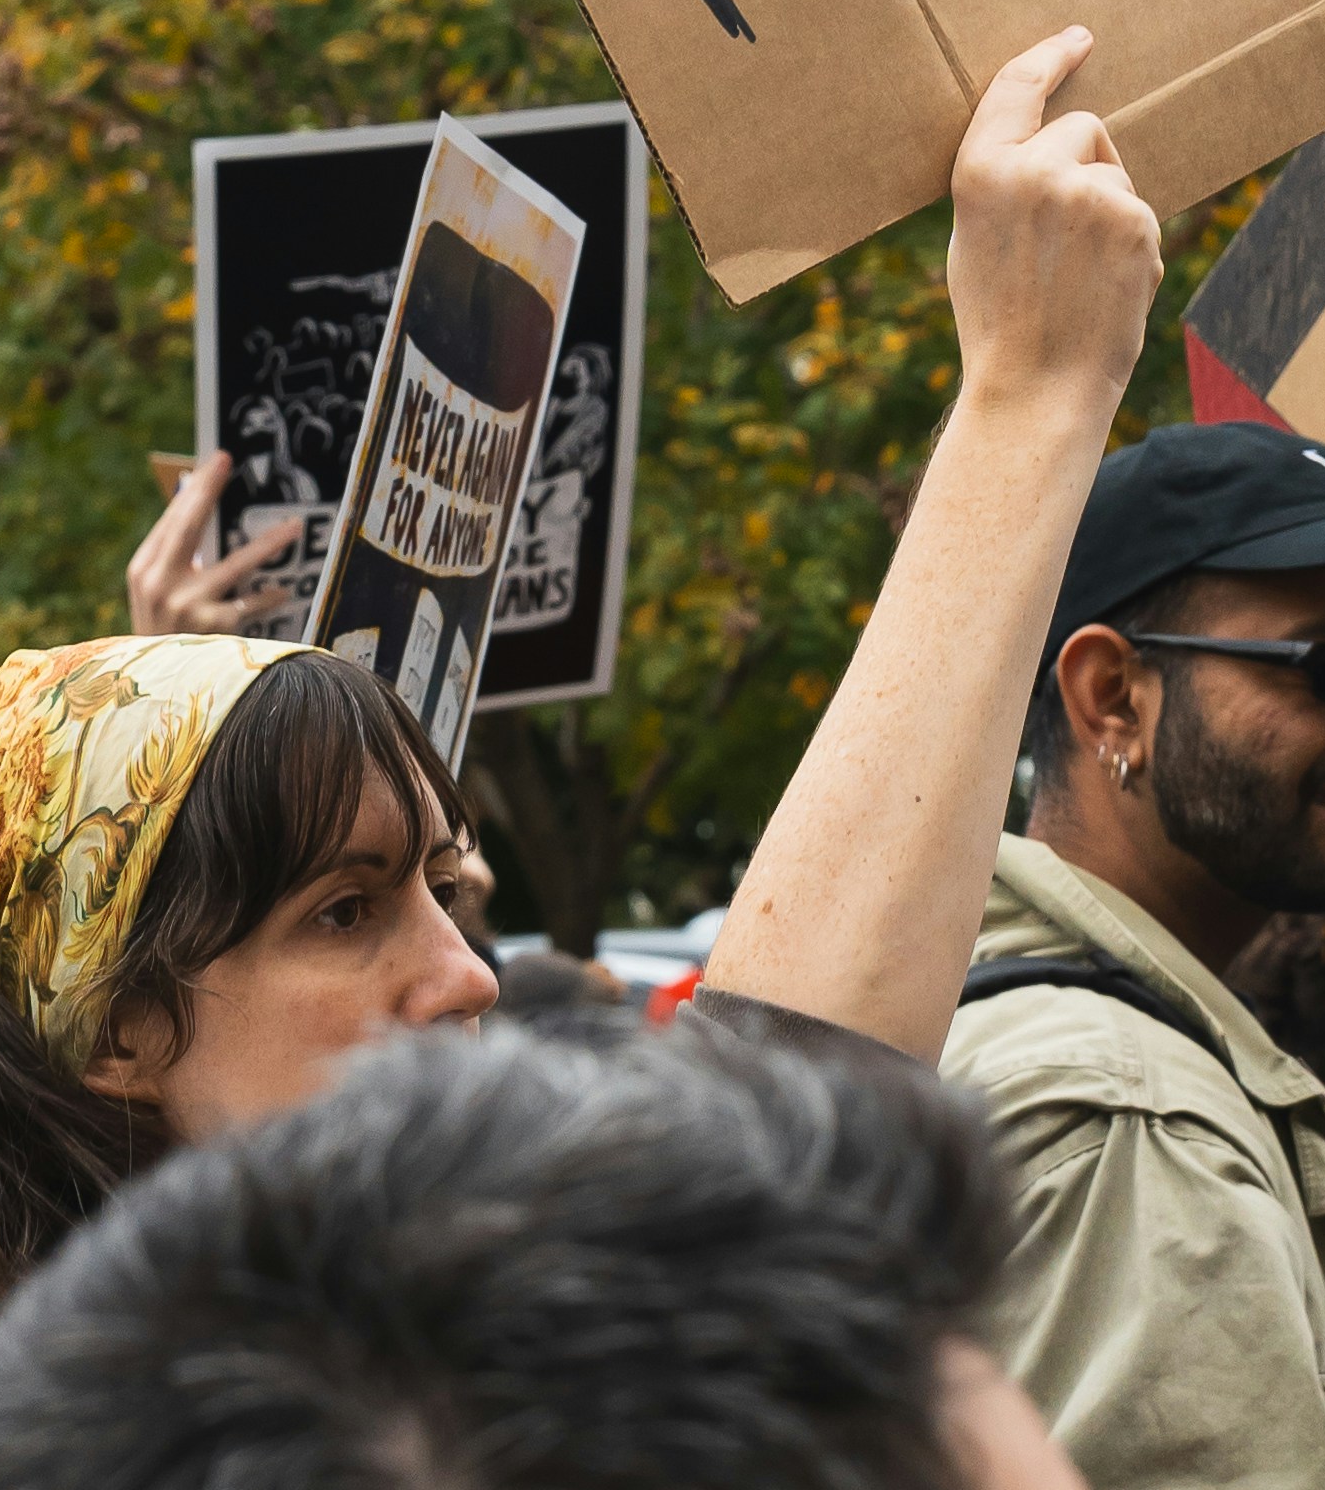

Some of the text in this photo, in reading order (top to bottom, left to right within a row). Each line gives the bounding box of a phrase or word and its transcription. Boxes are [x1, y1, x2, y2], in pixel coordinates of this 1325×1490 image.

[391, 378, 517, 505] NEVER AGAIN
[379, 476, 426, 556] FOR
[424, 503, 493, 567] ANYONE
